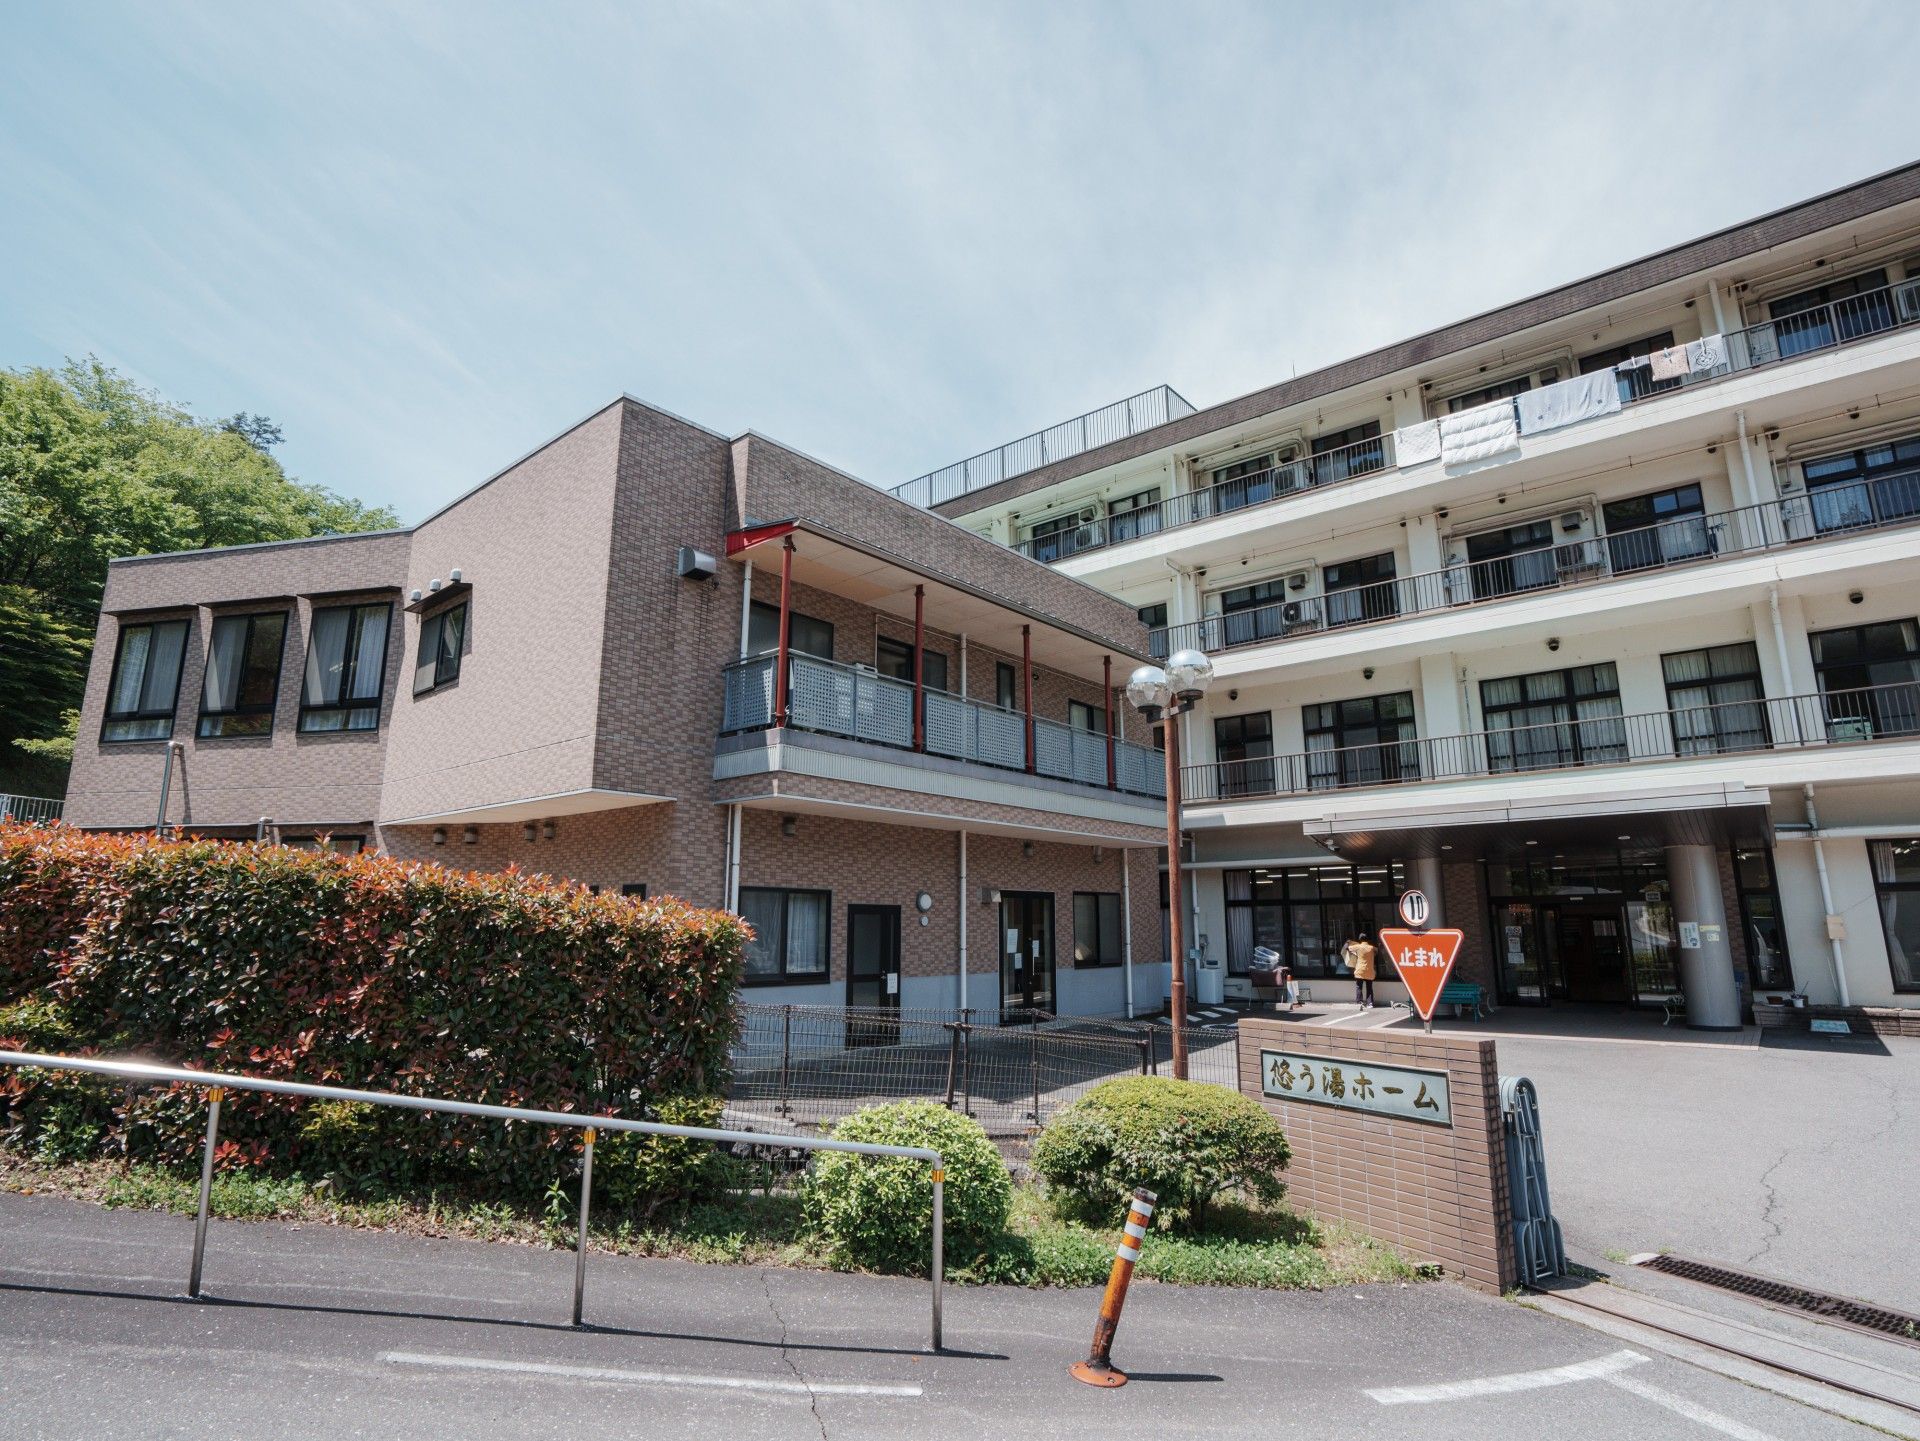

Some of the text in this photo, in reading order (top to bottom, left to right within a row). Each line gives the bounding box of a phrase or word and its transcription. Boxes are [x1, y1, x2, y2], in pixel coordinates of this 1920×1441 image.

[1409, 896, 1423, 920] 10
[1399, 947, 1445, 968] 止まれ
[1270, 1058, 1439, 1112] 悠う湯ホーム
